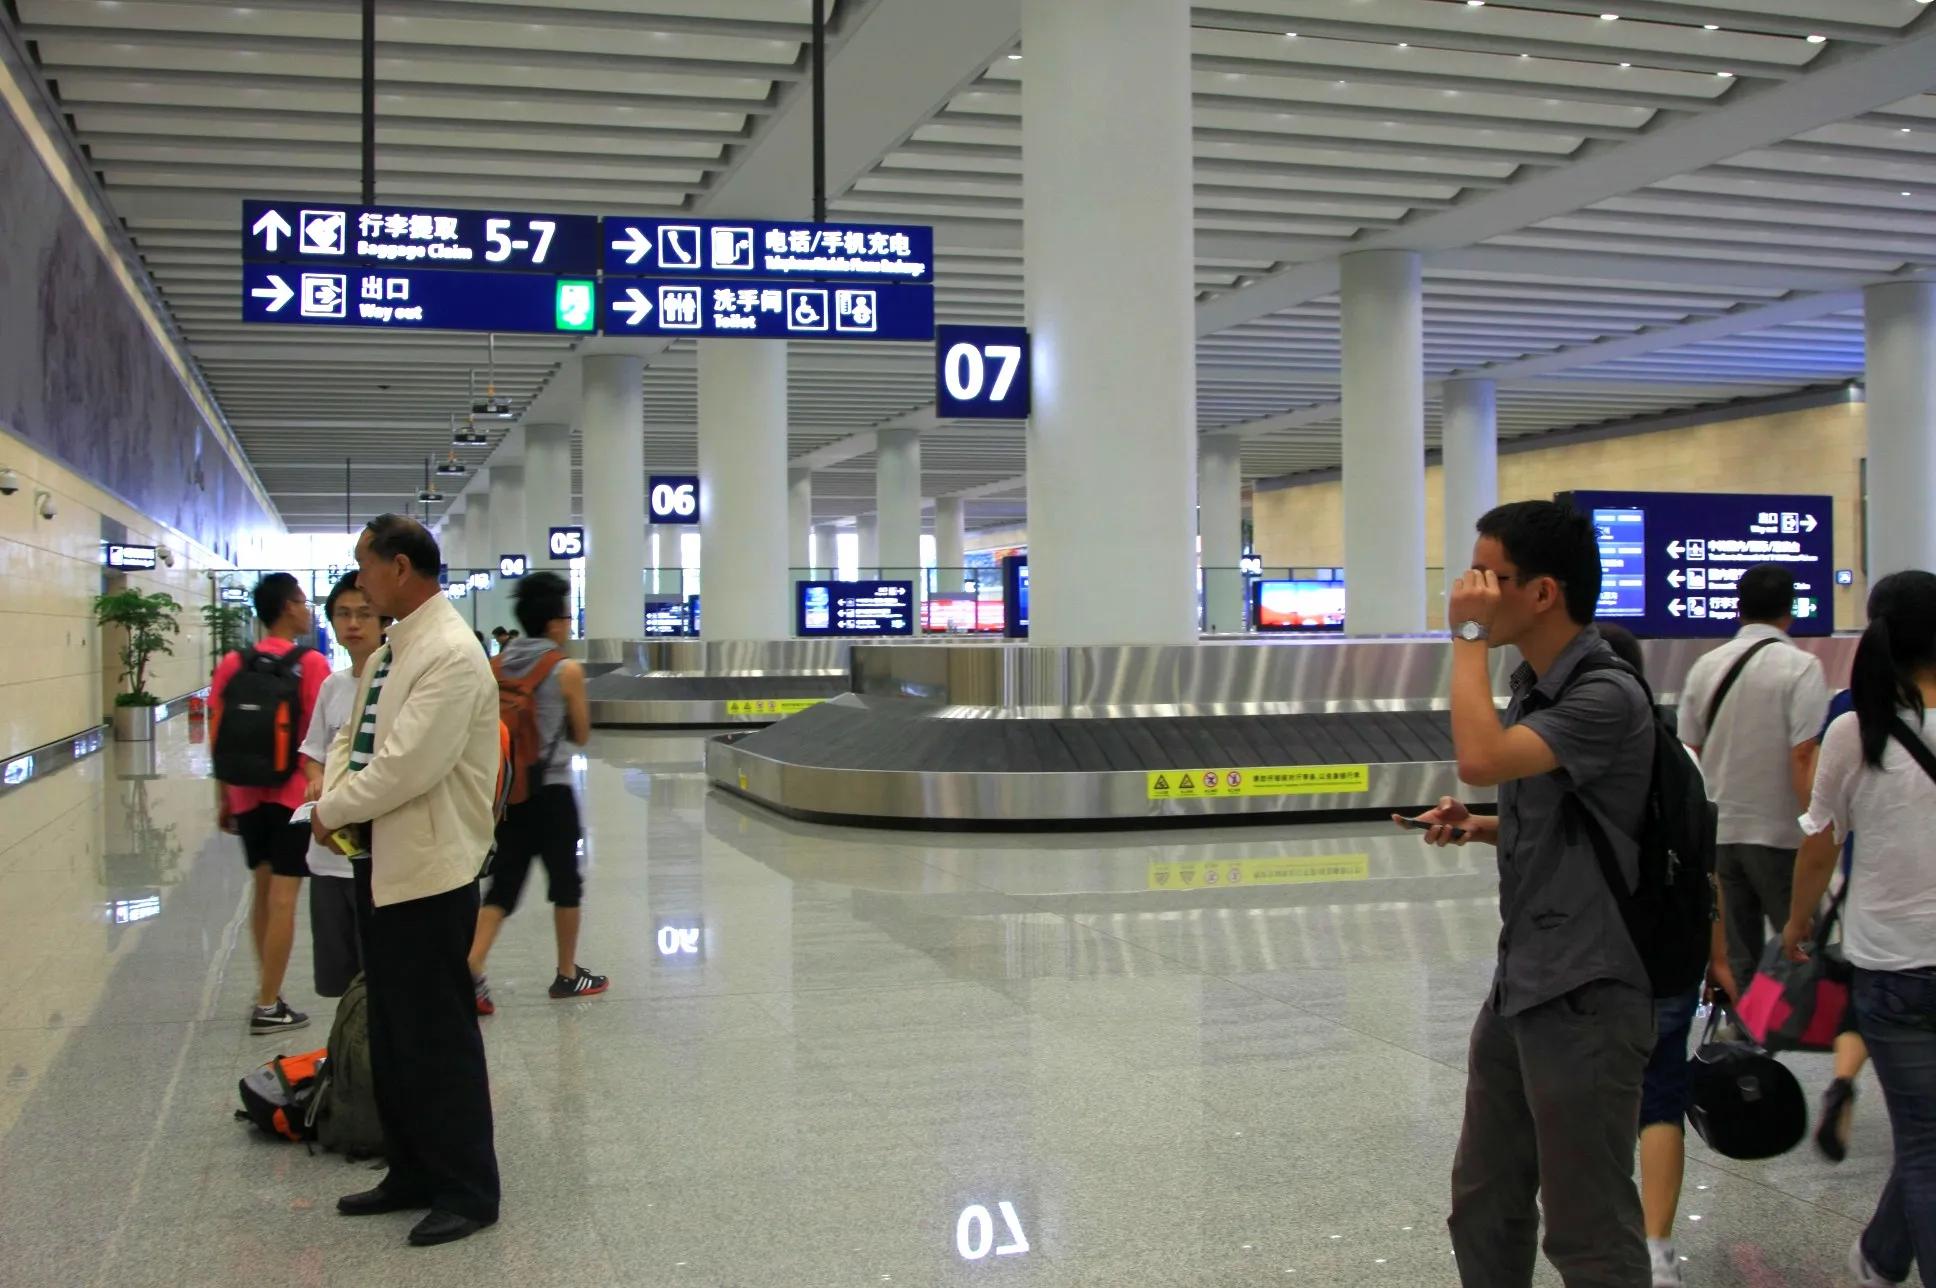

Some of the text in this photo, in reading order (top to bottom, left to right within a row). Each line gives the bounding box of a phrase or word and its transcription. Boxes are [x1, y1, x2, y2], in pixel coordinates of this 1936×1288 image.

[359, 213, 458, 240] 行李提取
[357, 241, 473, 260] Baggage Claim
[485, 218, 556, 262] 5-7
[765, 229, 912, 256] 电话/手机充电
[361, 275, 409, 300] 出口
[359, 303, 423, 322] Way out
[713, 288, 782, 313] 洗手间
[713, 313, 757, 329] Toilet
[944, 342, 1021, 401] 07
[651, 484, 697, 516] 06
[550, 532, 582, 554] 05
[500, 558, 524, 576] 04
